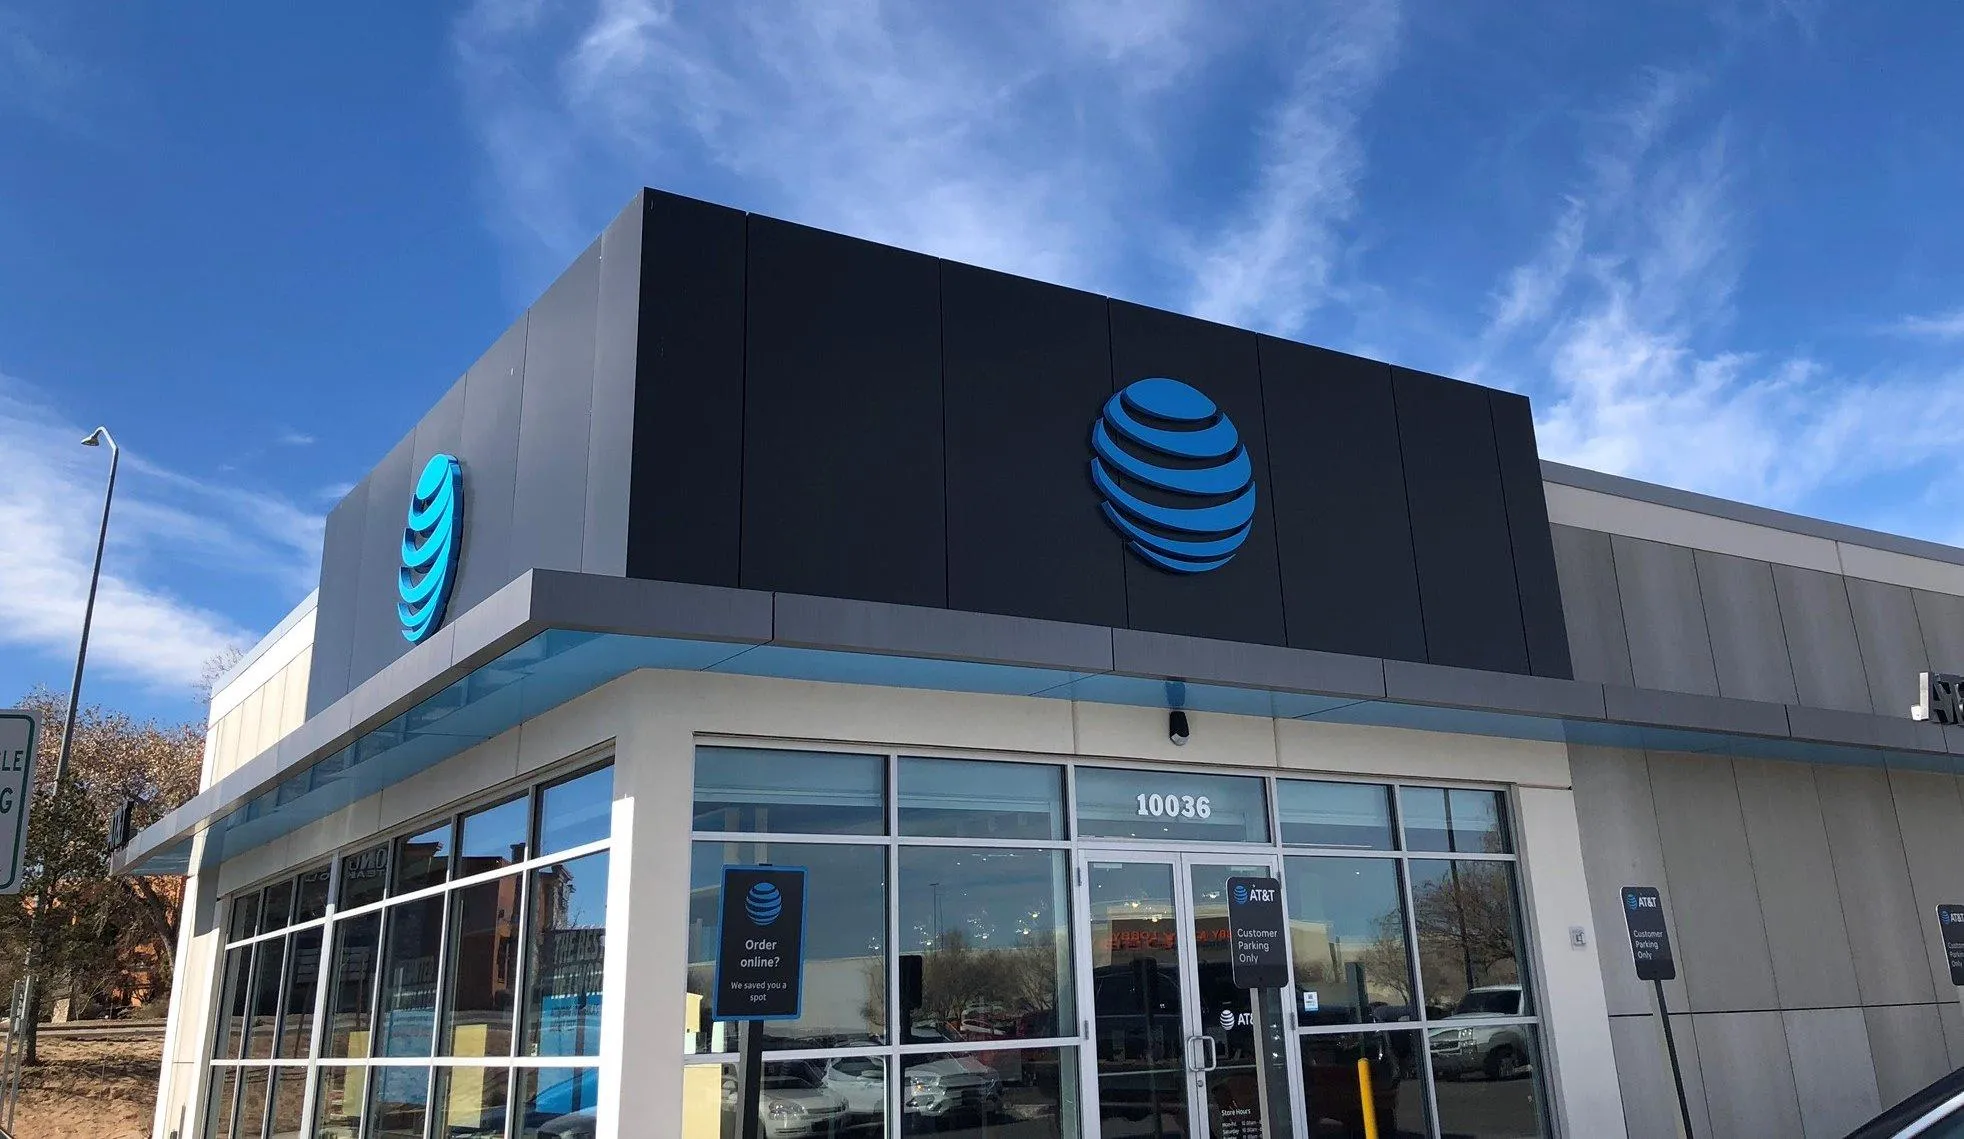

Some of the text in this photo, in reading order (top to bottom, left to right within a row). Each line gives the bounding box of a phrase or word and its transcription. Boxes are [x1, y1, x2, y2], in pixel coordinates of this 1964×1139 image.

[0, 750, 23, 771] LE
[1137, 793, 1211, 818] 10036
[1250, 889, 1275, 902] AT&T
[1638, 896, 1657, 908] AT&T
[1237, 928, 1278, 938] Customer
[1633, 930, 1663, 938] Customer
[745, 939, 777, 950] Order
[1238, 941, 1269, 952] Parking
[1635, 940, 1659, 950] Parking
[1239, 953, 1259, 964] Only
[1637, 951, 1652, 960] Only
[740, 956, 780, 968] online?
[730, 981, 743, 990] We
[744, 981, 766, 990] saved
[767, 982, 781, 991] you
[750, 994, 767, 1003] spot
[1237, 1012, 1254, 1026] AT
[1221, 1109, 1236, 1117] Store
